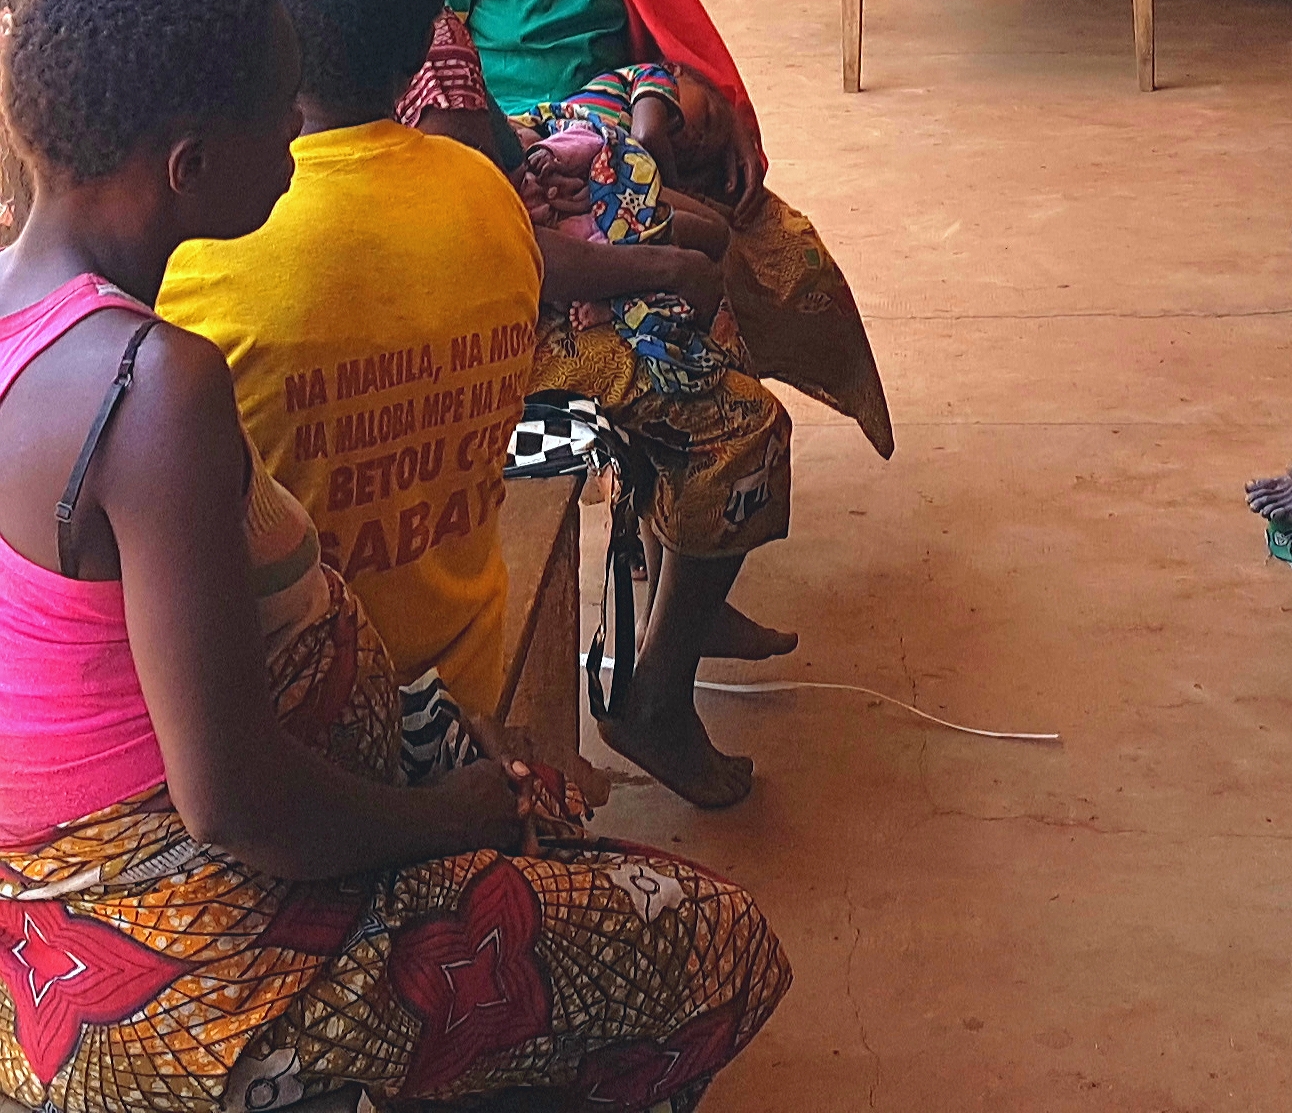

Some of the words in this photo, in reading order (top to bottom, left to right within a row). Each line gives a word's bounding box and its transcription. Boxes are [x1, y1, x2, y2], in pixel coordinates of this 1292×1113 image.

[284, 368, 328, 413] NA
[337, 344, 443, 400] MAKILA,
[450, 333, 484, 373] NA
[295, 422, 328, 462] NA
[335, 399, 417, 453] MALOBA
[421, 387, 465, 429] MPE
[469, 379, 494, 419] NA
[327, 437, 445, 513] BETOU
